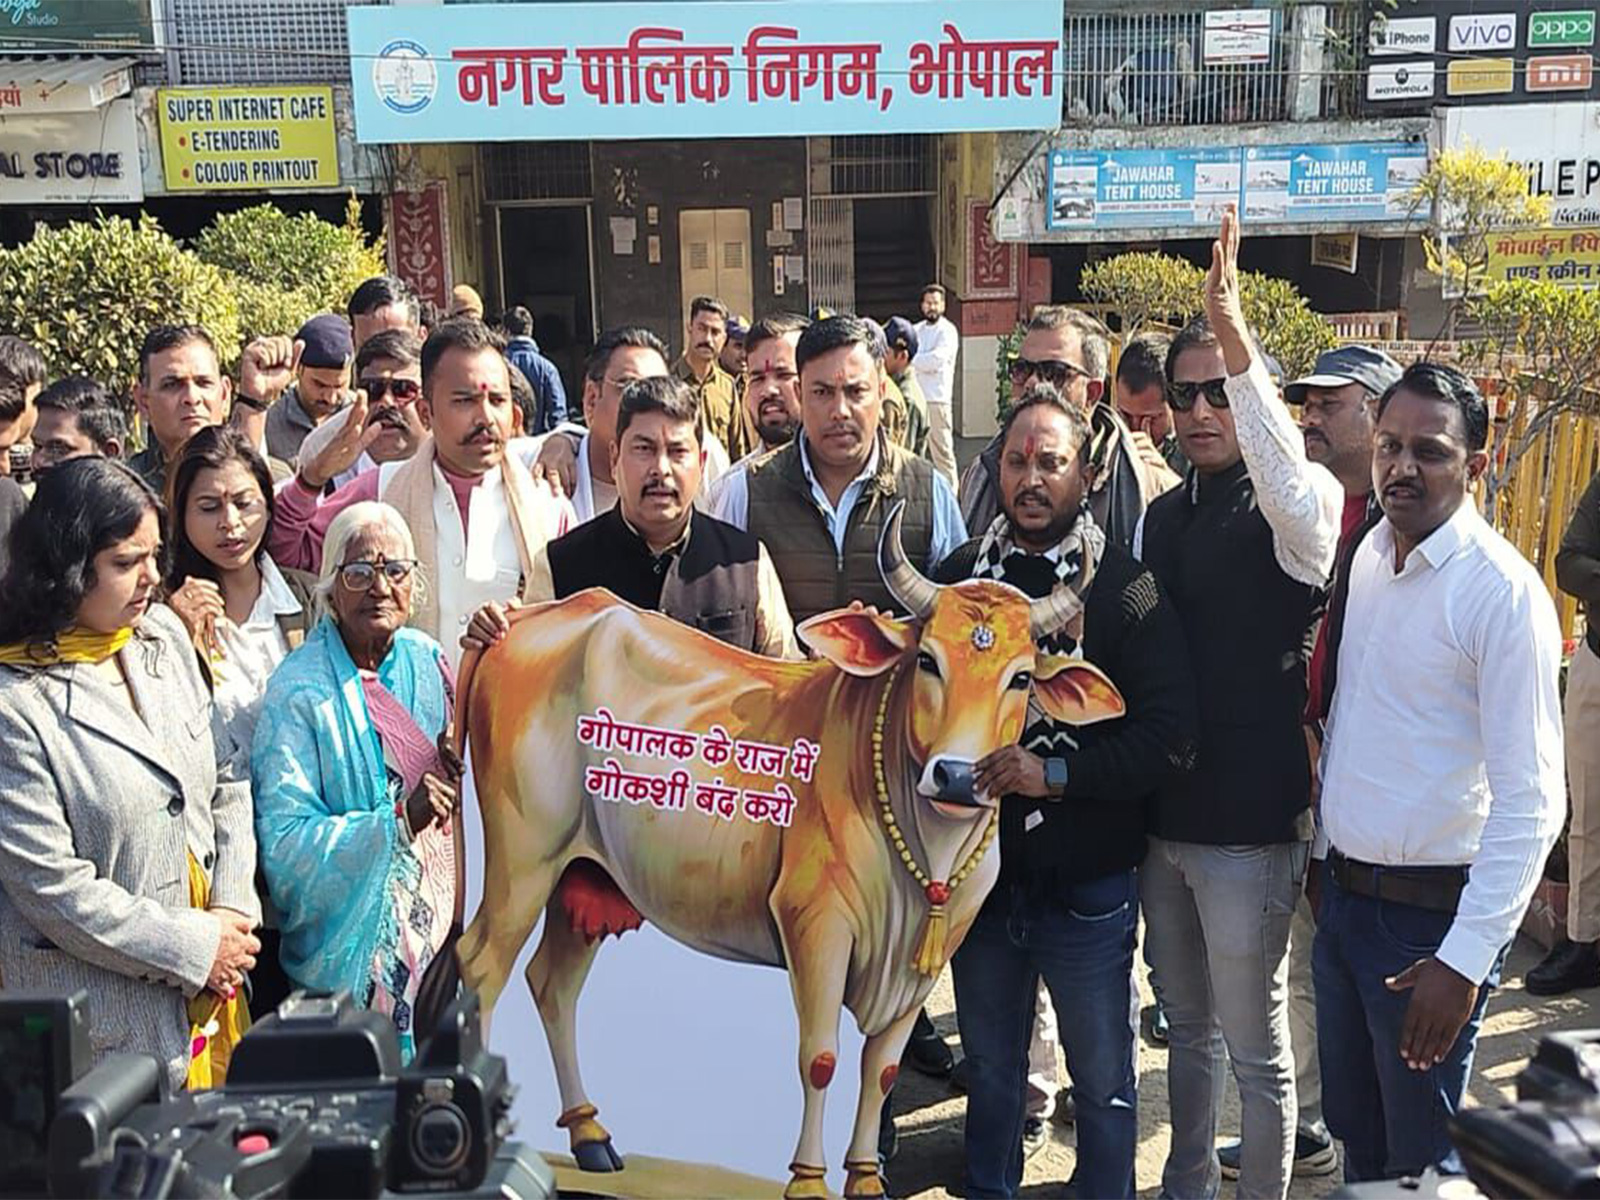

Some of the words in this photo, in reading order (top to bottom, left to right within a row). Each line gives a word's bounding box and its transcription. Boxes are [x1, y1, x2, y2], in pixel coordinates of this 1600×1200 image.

[27, 12, 59, 26] Studio
[1389, 31, 1430, 45] iPhone
[1456, 20, 1512, 44] vivo
[1533, 20, 1591, 40] oppo
[451, 48, 568, 107] नगर
[575, 27, 734, 105] पालिक
[742, 25, 894, 111] निगम,
[909, 23, 1059, 99] भोपाल
[1375, 84, 1429, 95] MOTOROLA
[167, 100, 214, 122] SUPER
[219, 98, 286, 121] INTERNET
[290, 97, 326, 119] CAFE
[192, 130, 280, 151] E-TENDERING
[34, 152, 122, 179] STORE
[195, 162, 250, 184] COLOUR
[253, 160, 319, 182] PRINTOUT
[1112, 165, 1175, 182] JAWAHAR
[1305, 160, 1367, 177] JAWAHAR
[1104, 184, 1137, 201] TENT
[1140, 183, 1182, 200] HOUSE
[1297, 178, 1329, 195] TENT
[1332, 177, 1374, 193] HOUSE
[579, 709, 698, 760] गोपालक
[703, 727, 731, 765] के
[737, 742, 788, 776] राज
[792, 740, 819, 779] में
[587, 760, 690, 809] गोकशी
[696, 778, 738, 818] बंद
[744, 786, 795, 825] करो
